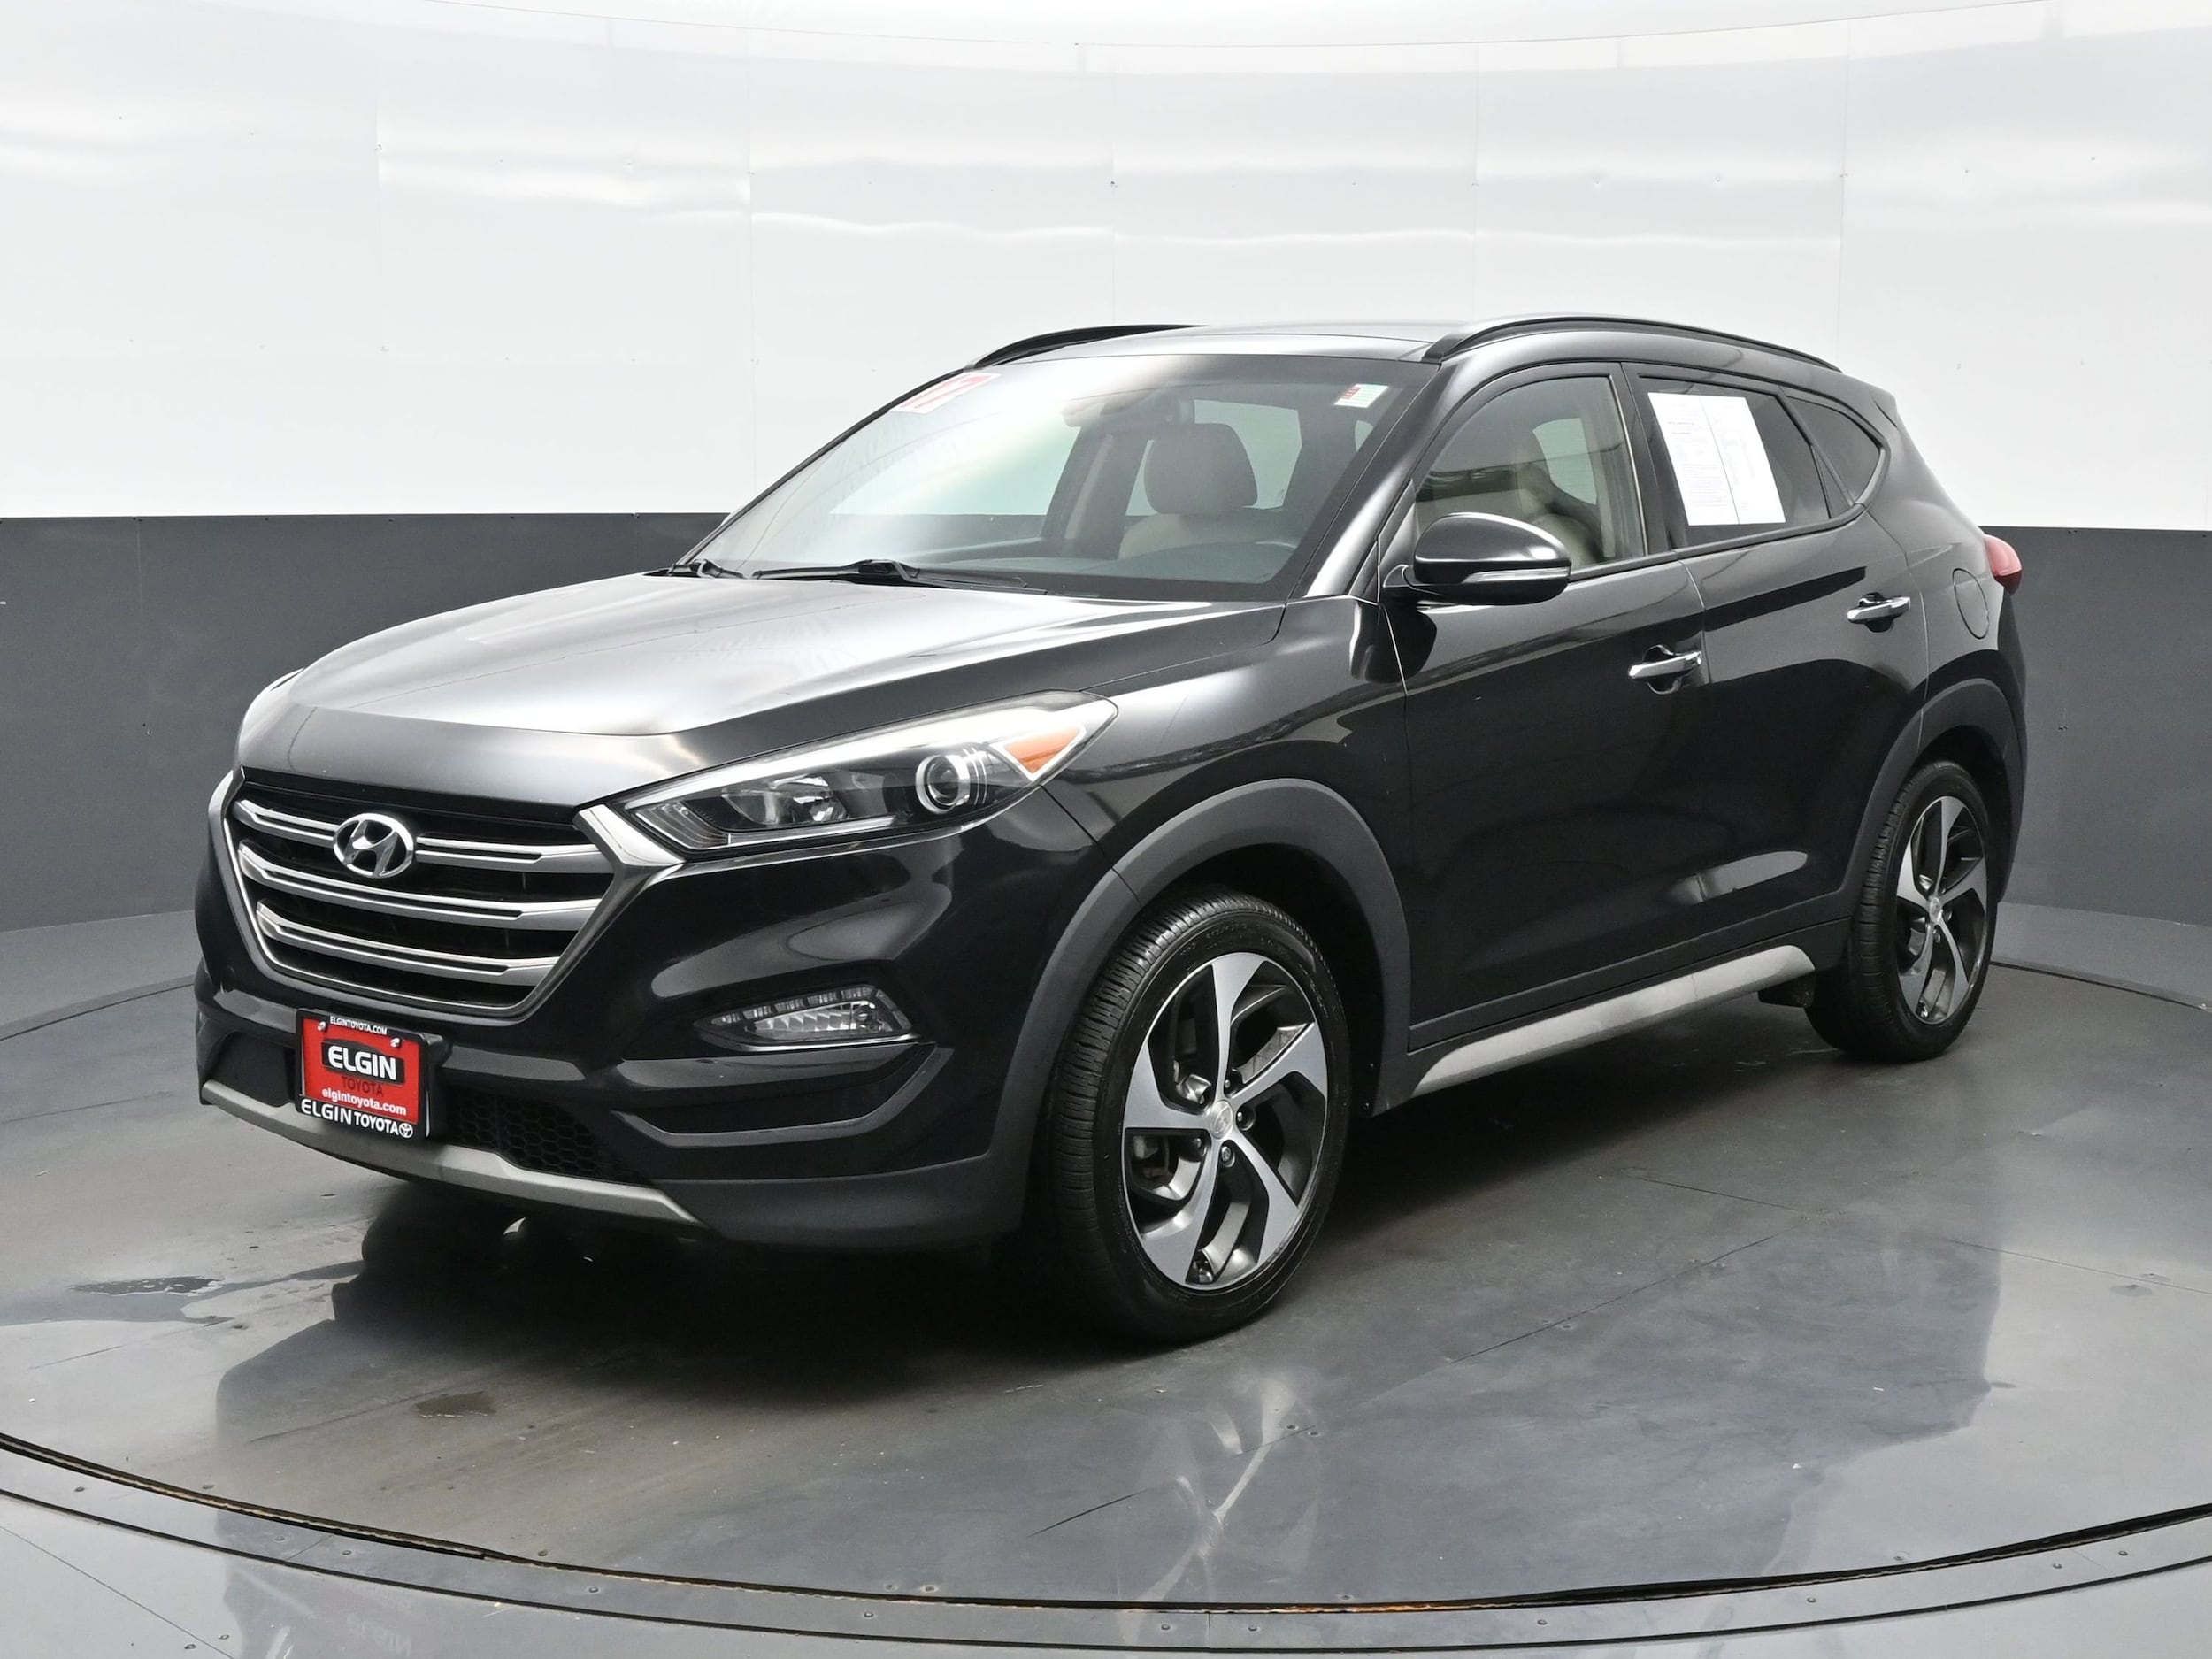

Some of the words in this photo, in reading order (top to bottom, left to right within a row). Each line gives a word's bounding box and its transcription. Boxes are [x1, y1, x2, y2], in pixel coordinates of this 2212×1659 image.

[330, 1016, 388, 1035] ELGINTOYOTA.COM
[328, 1045, 396, 1080] ELGIN
[341, 1075, 383, 1097] TOYOTA
[322, 1087, 406, 1116] elgintoyota.com
[301, 1098, 352, 1125] ELGIN
[354, 1111, 398, 1135] TOYOTA
